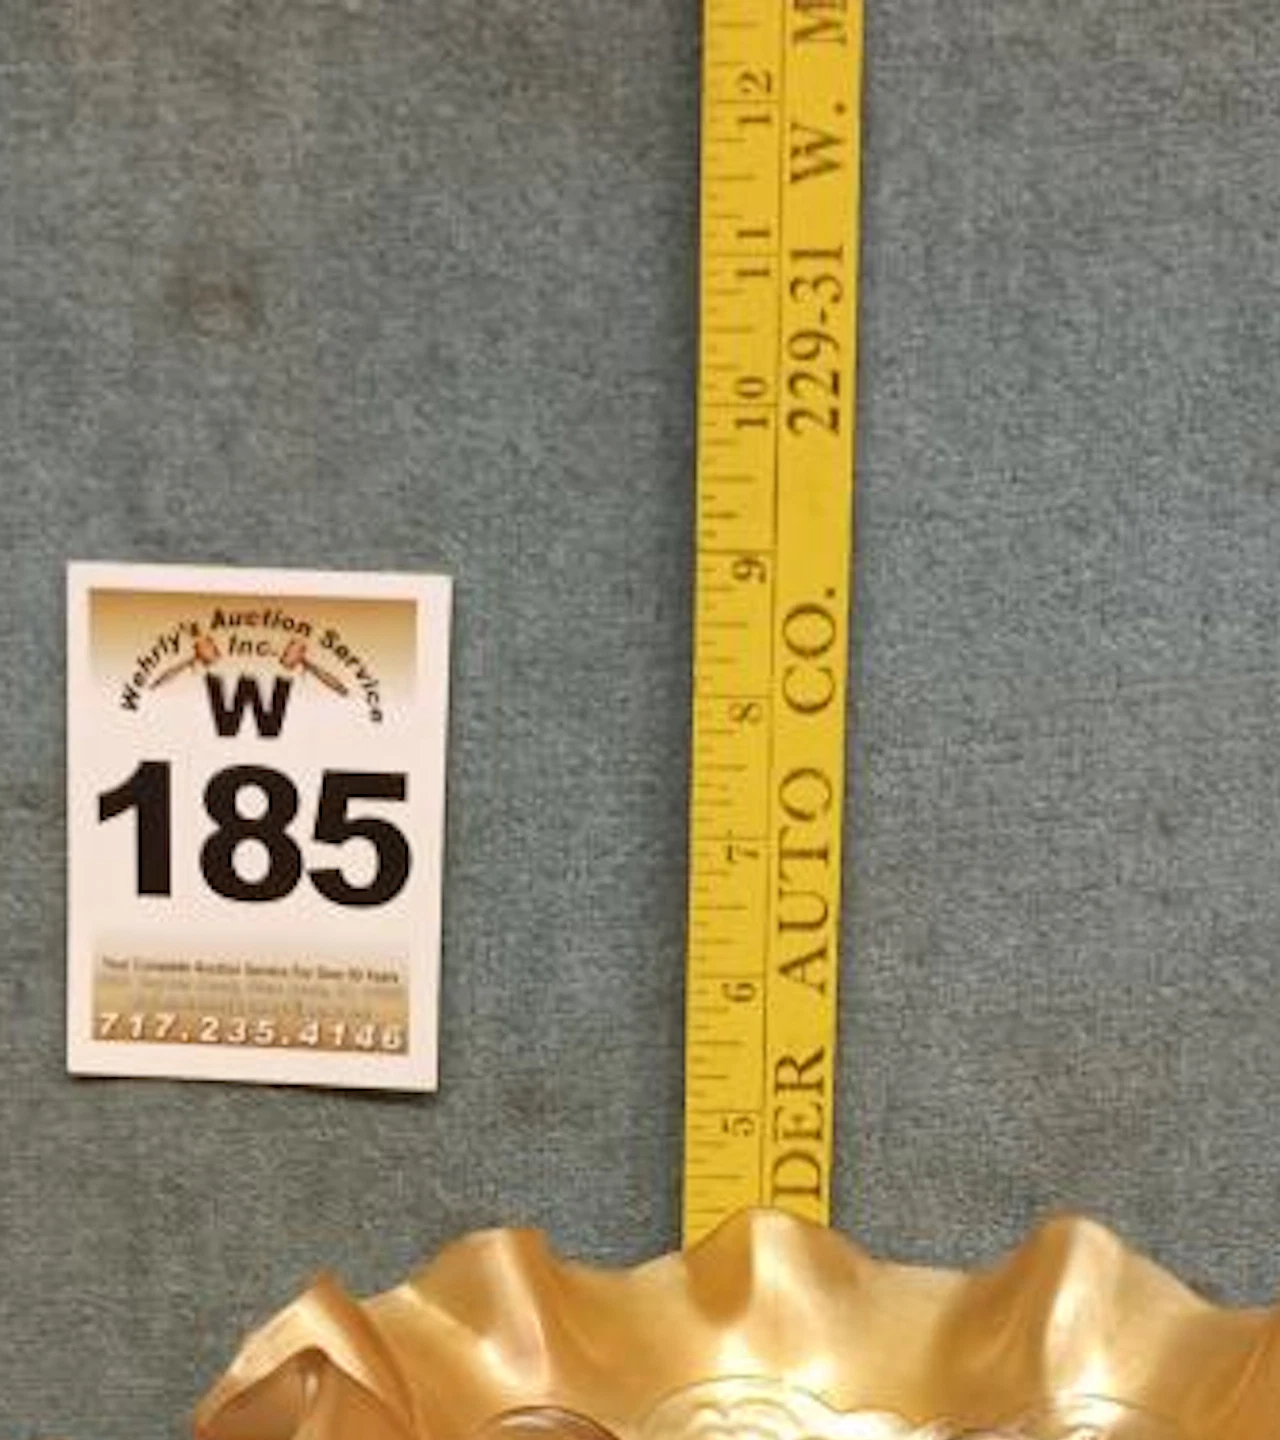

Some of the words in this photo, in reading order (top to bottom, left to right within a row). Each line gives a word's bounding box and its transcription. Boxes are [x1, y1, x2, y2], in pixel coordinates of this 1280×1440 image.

[736, 70, 771, 125] 12
[789, 102, 846, 184] W.
[735, 229, 770, 277] 11
[786, 244, 844, 436] 229-31
[734, 376, 768, 429] 10
[731, 556, 766, 584] 9
[120, 620, 199, 712] Wehrly's
[210, 608, 312, 638] Auction
[319, 628, 384, 725] Service
[227, 634, 279, 657] Inc.
[782, 588, 836, 715] CO.
[204, 673, 293, 738] W
[727, 701, 762, 725] 8
[98, 760, 411, 909] 185
[777, 768, 832, 995] AUTO
[722, 982, 756, 1003] 6
[722, 1116, 755, 1138] 5
[772, 1045, 825, 1202] DER
